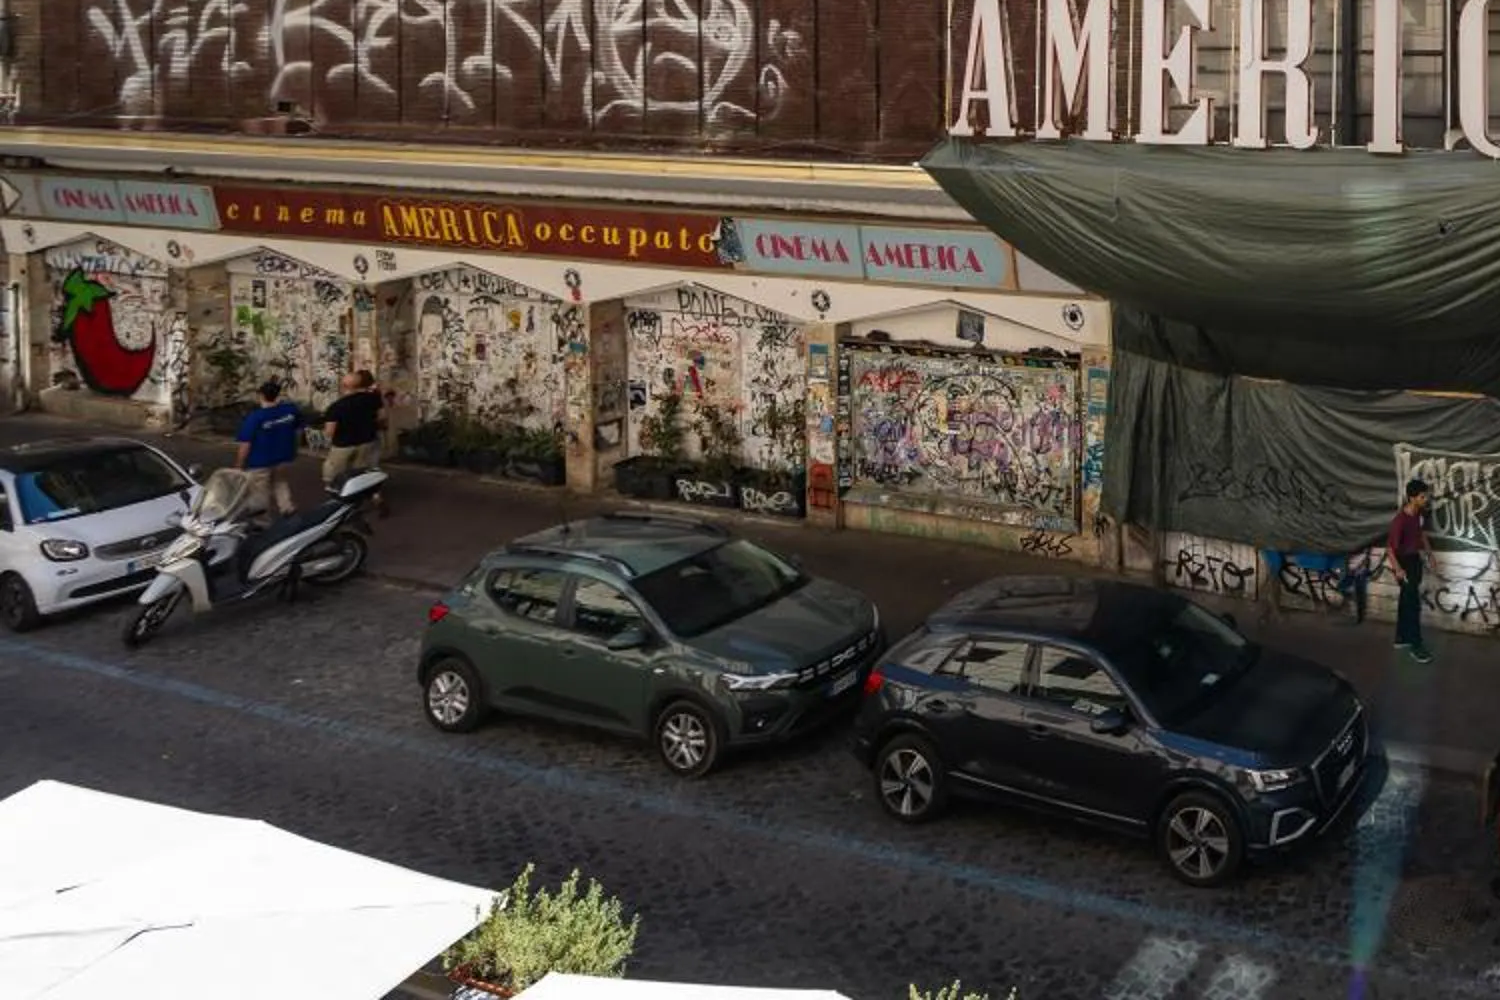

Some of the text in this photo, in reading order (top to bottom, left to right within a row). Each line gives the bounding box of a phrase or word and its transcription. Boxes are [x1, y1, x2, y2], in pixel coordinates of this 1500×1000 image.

[226, 203, 716, 257] cinema AMERICA occupato
[755, 231, 984, 273] CINEMA AMERICA
